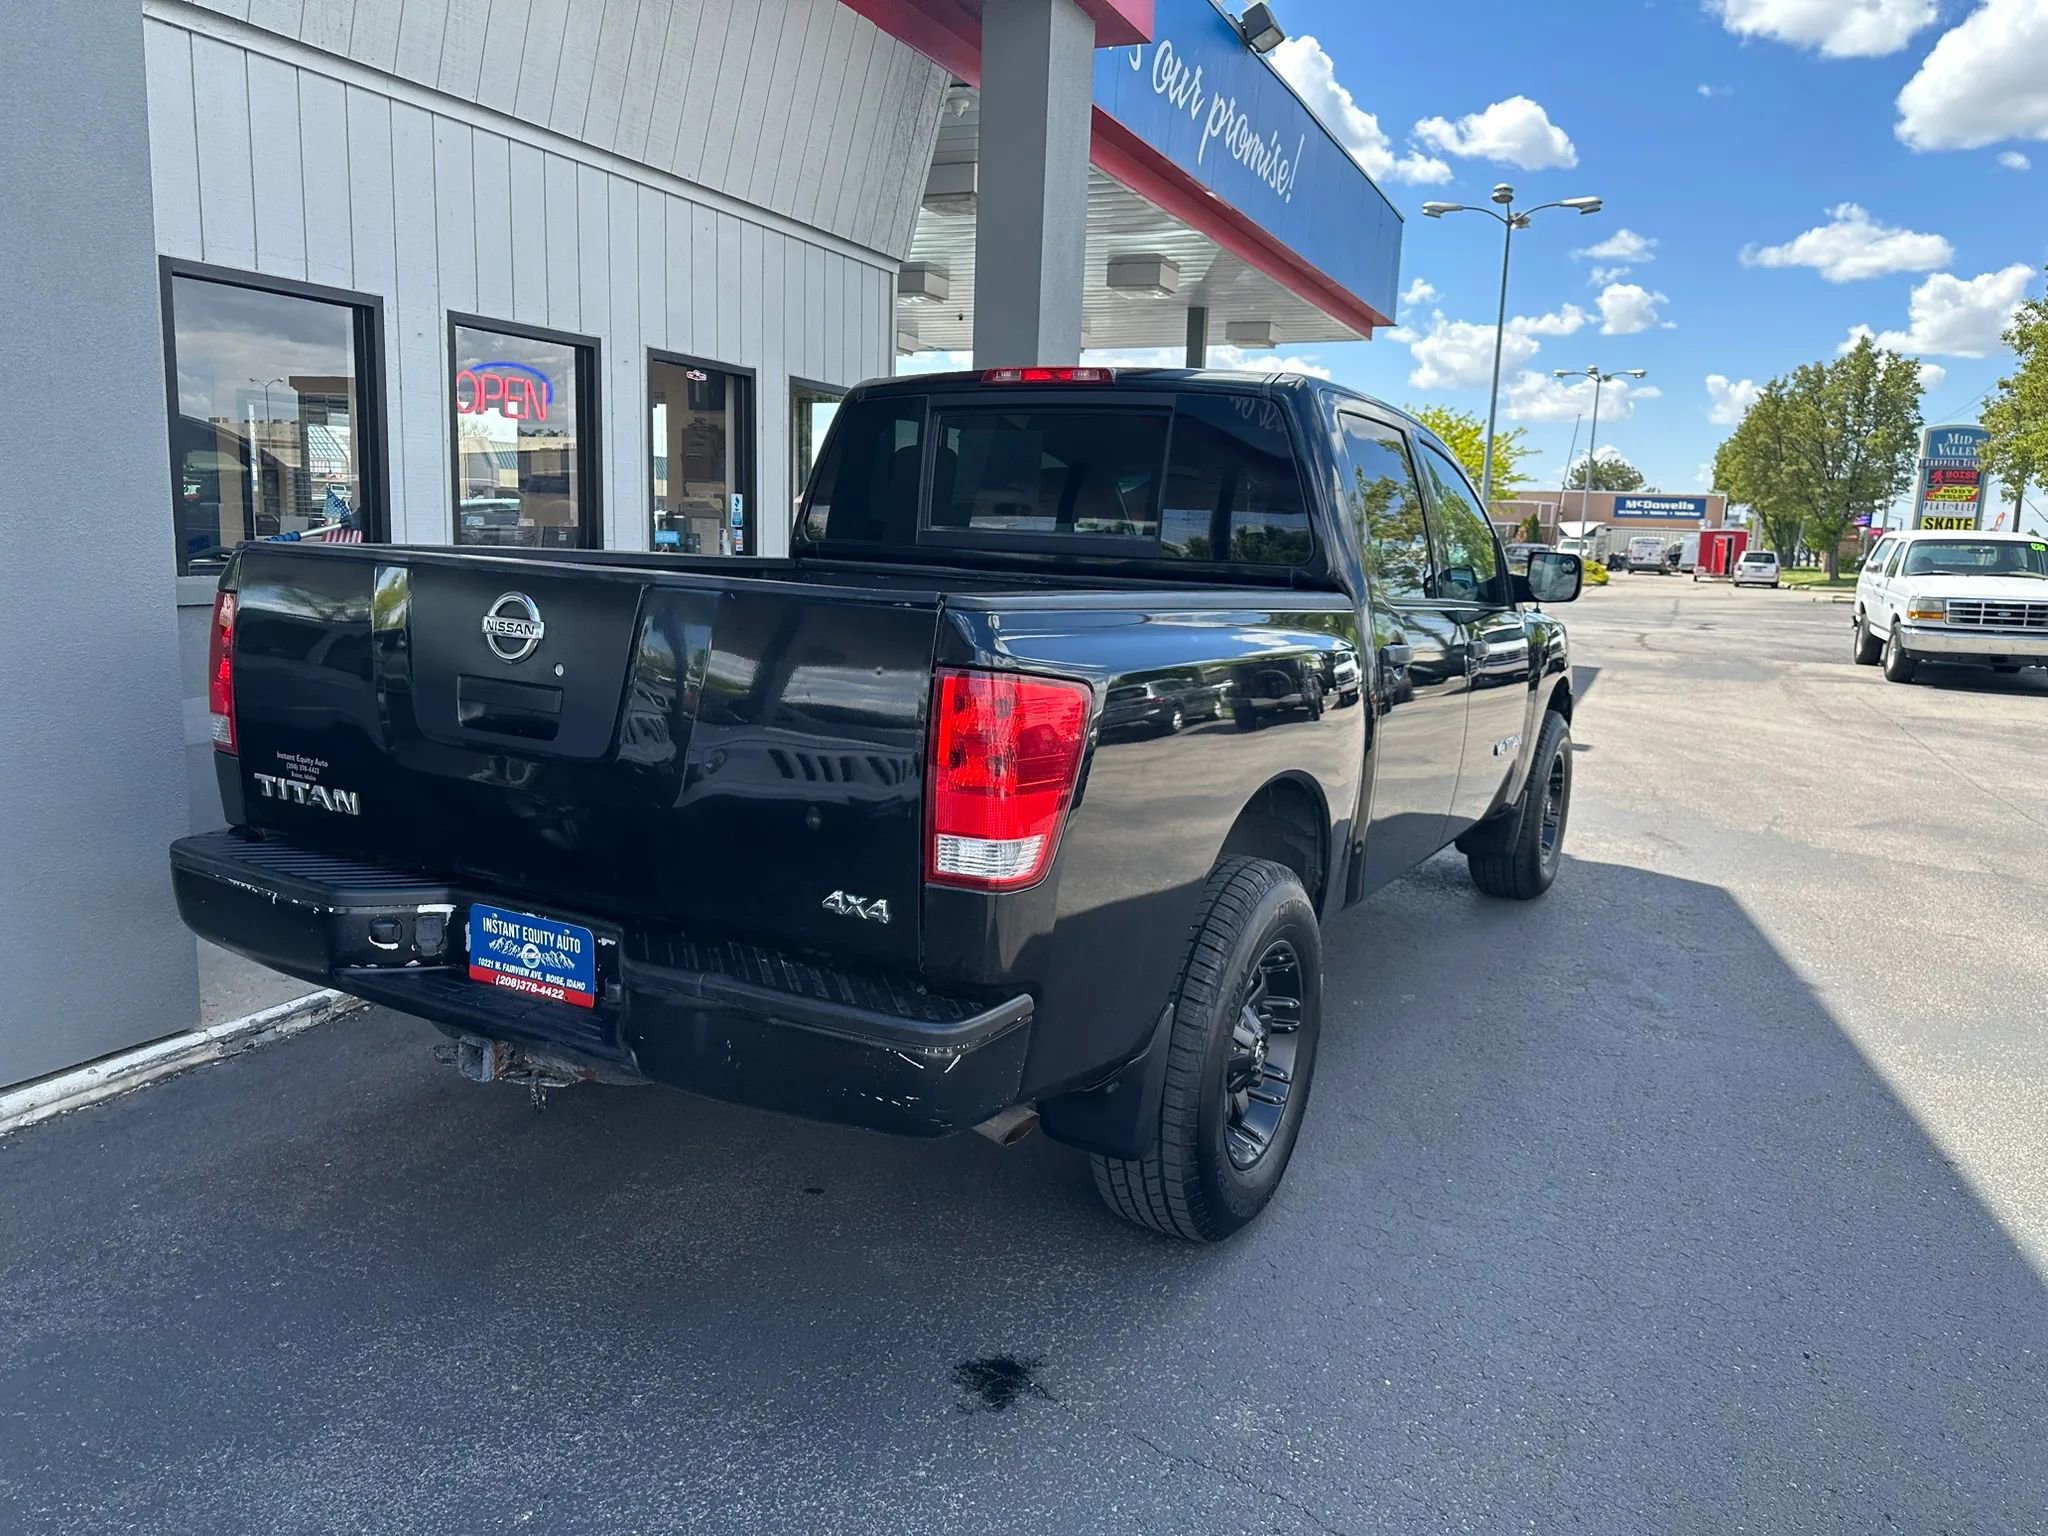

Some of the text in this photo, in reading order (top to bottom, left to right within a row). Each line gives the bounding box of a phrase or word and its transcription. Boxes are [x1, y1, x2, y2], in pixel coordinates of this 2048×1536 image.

[1152, 39, 1305, 203] our promise!
[457, 369, 547, 422] OPEN
[1923, 517, 1973, 530] SKATE
[487, 620, 535, 635] NISSAN
[254, 772, 360, 815] TITAN
[483, 917, 581, 954] INSTANT EQUITY AUTO
[495, 974, 565, 1000] (208)378-4422
[502, 962, 530, 976] FAIRVIEW
[529, 969, 543, 981] AVE.
[545, 973, 566, 988] BOISE,
[566, 979, 586, 991] IDAHO
